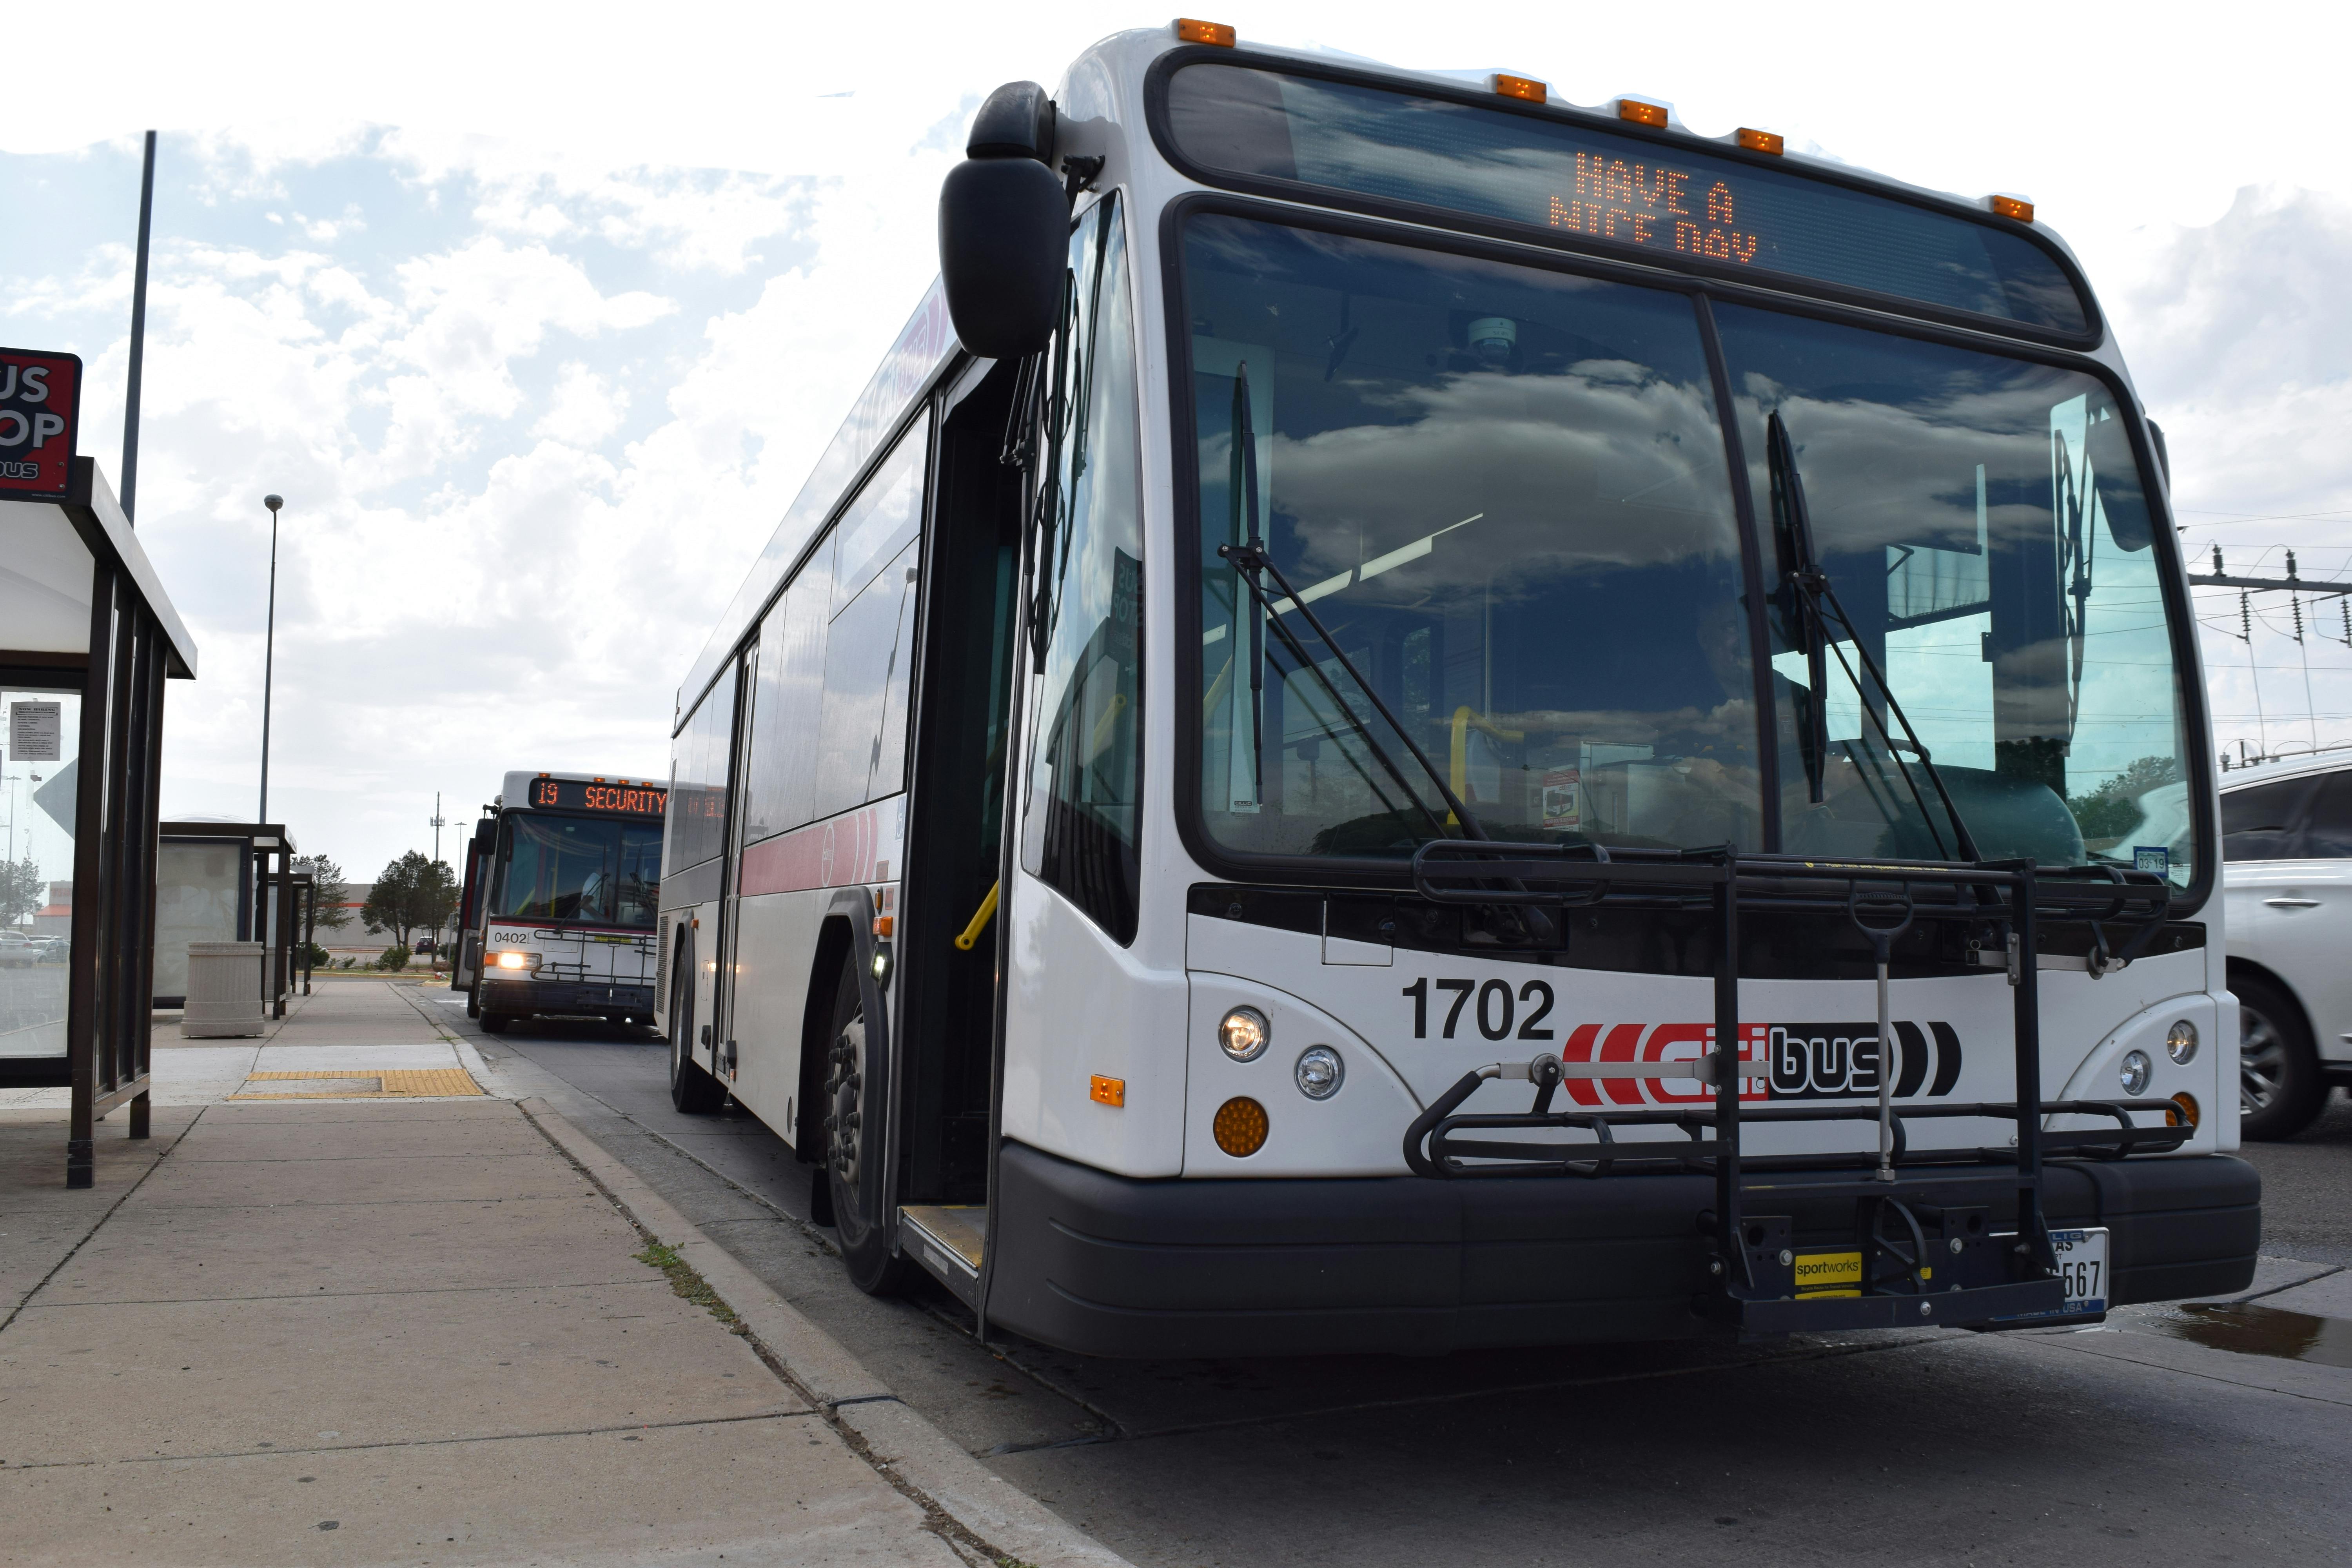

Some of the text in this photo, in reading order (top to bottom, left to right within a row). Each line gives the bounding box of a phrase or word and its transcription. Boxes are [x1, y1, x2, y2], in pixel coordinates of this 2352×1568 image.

[1577, 152, 1733, 224] HAVE A
[538, 782, 558, 804] 19
[585, 786, 667, 813] SECURITY
[2139, 858, 2164, 869] 03 19
[494, 932, 527, 944] 0402
[1402, 977, 1555, 1040] 1702
[1797, 1259, 1858, 1277] sportworks
[2050, 1261, 2100, 1298] 567
[2063, 1302, 2082, 1313] USA
